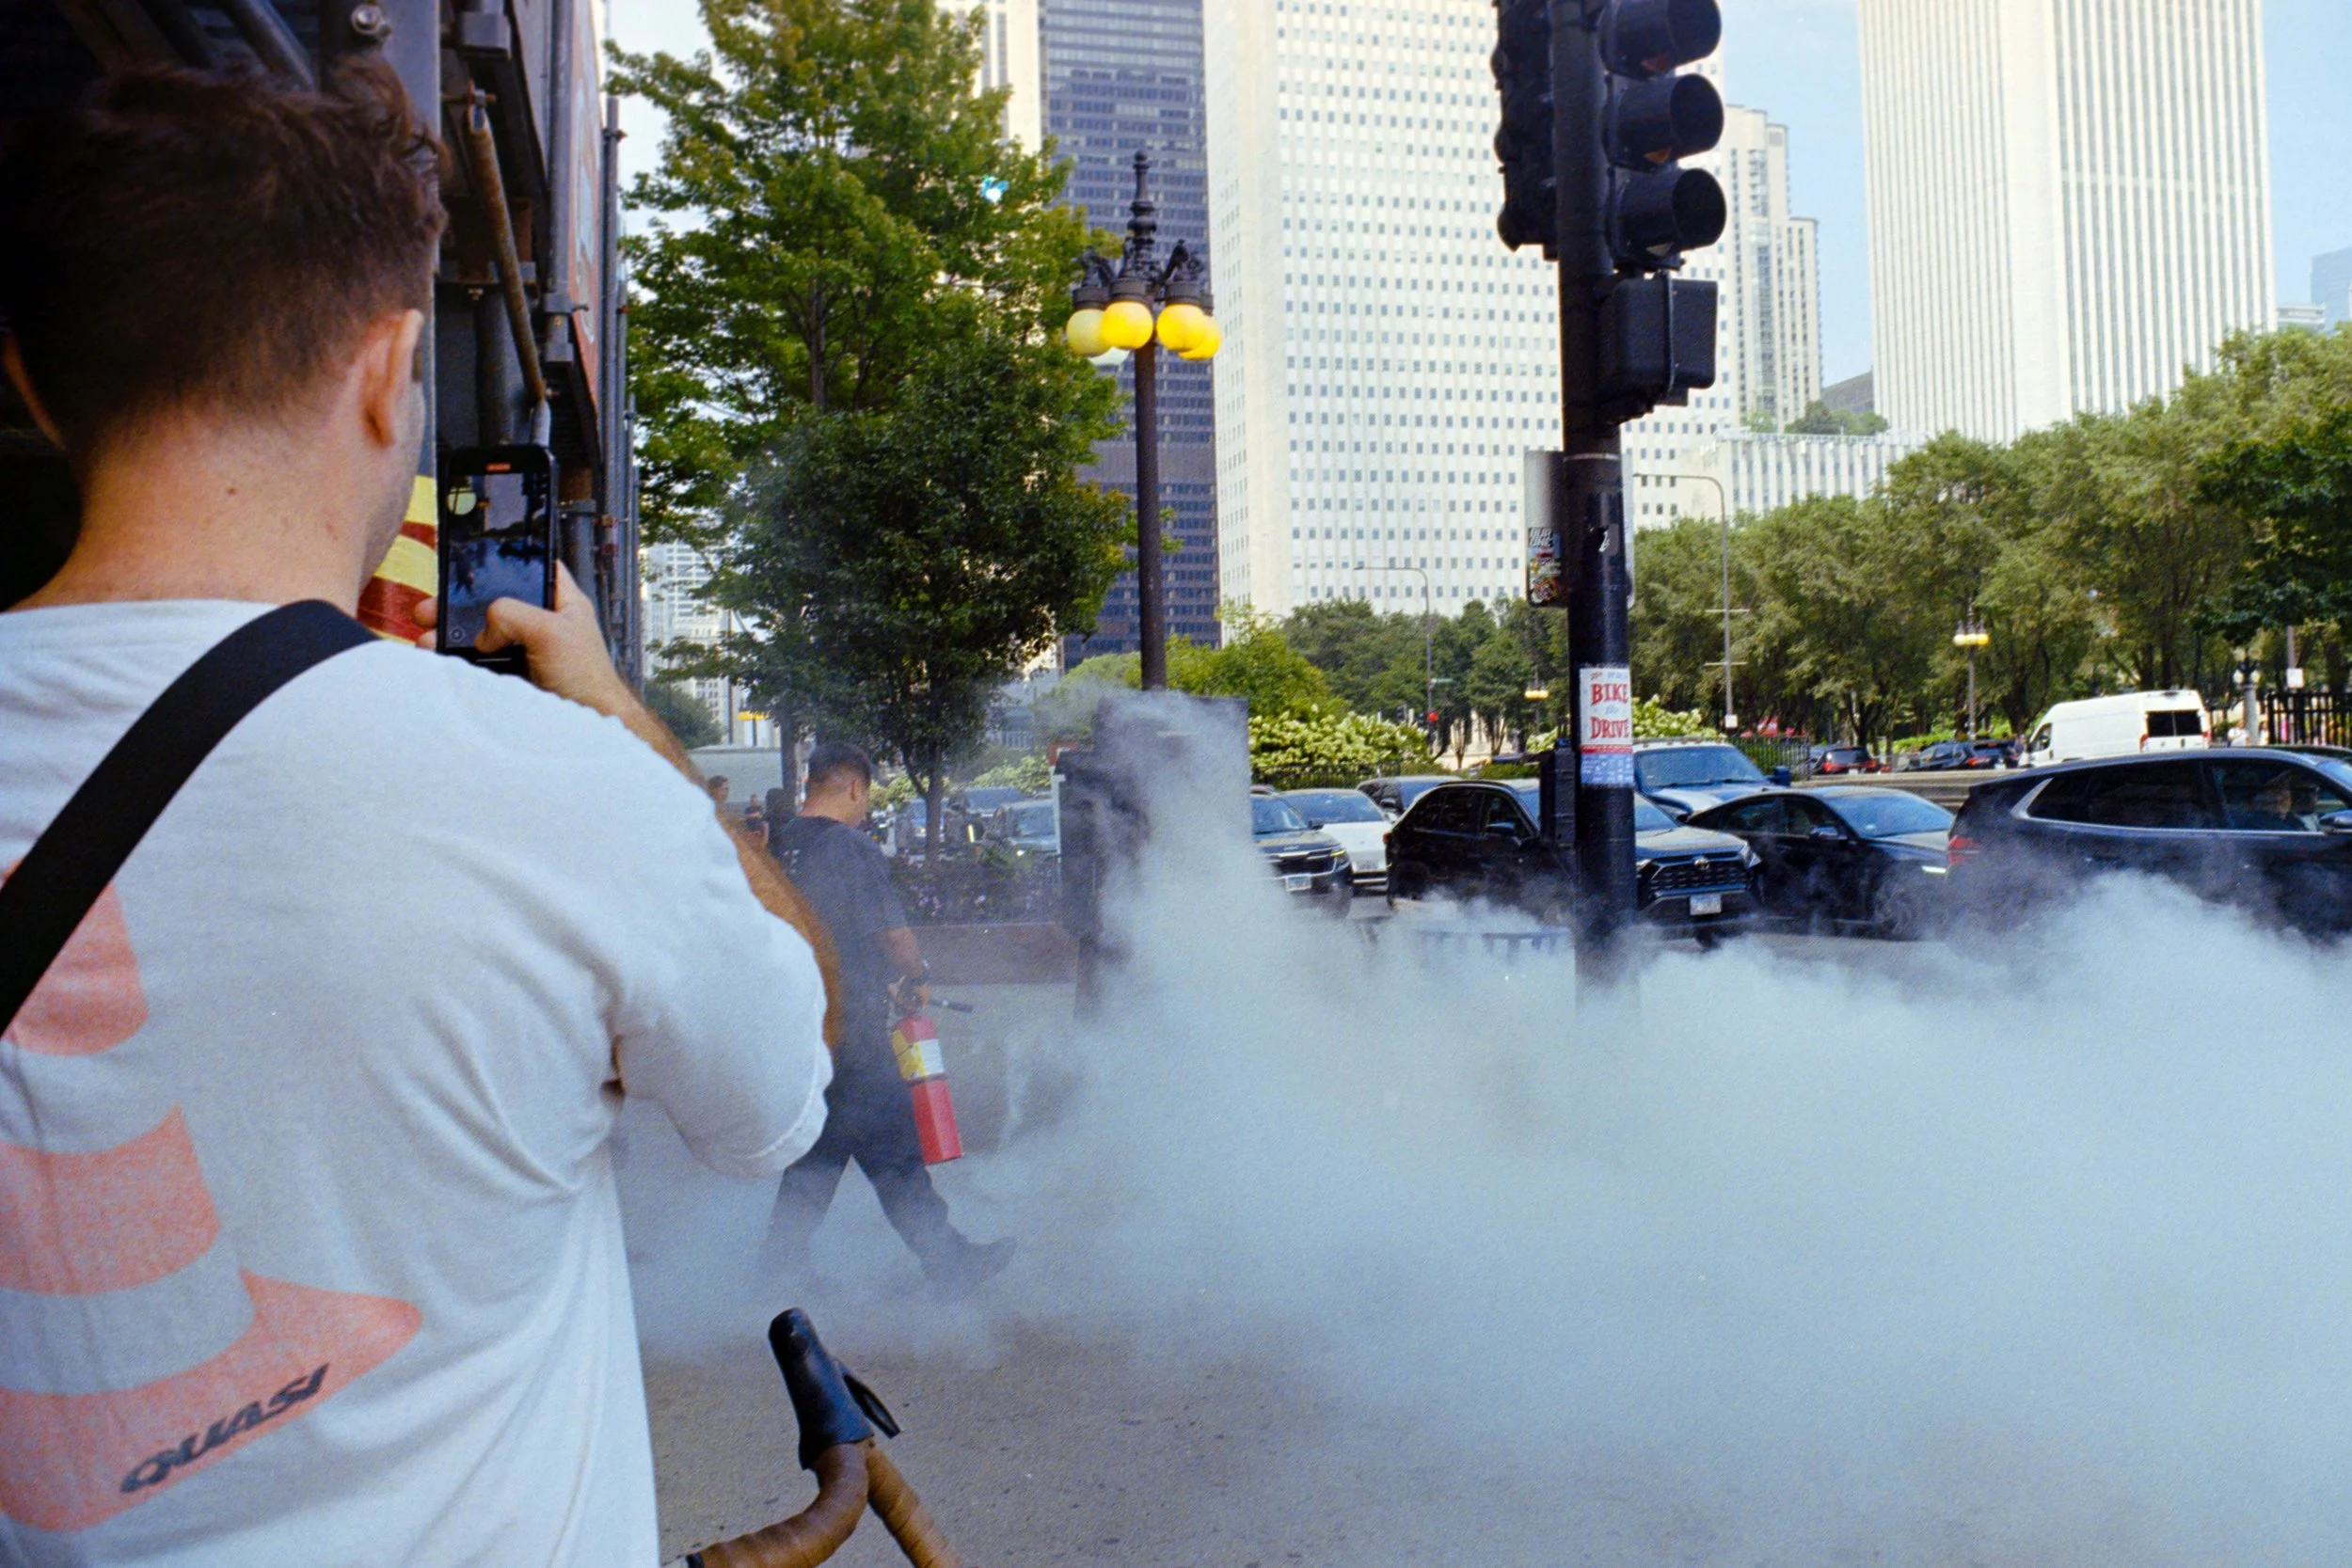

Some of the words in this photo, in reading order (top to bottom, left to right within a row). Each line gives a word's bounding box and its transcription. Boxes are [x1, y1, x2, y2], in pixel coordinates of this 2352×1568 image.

[1591, 682, 1629, 705] BIKE
[1589, 716, 1629, 739] DRIVE
[119, 1362, 330, 1494] QUASI
